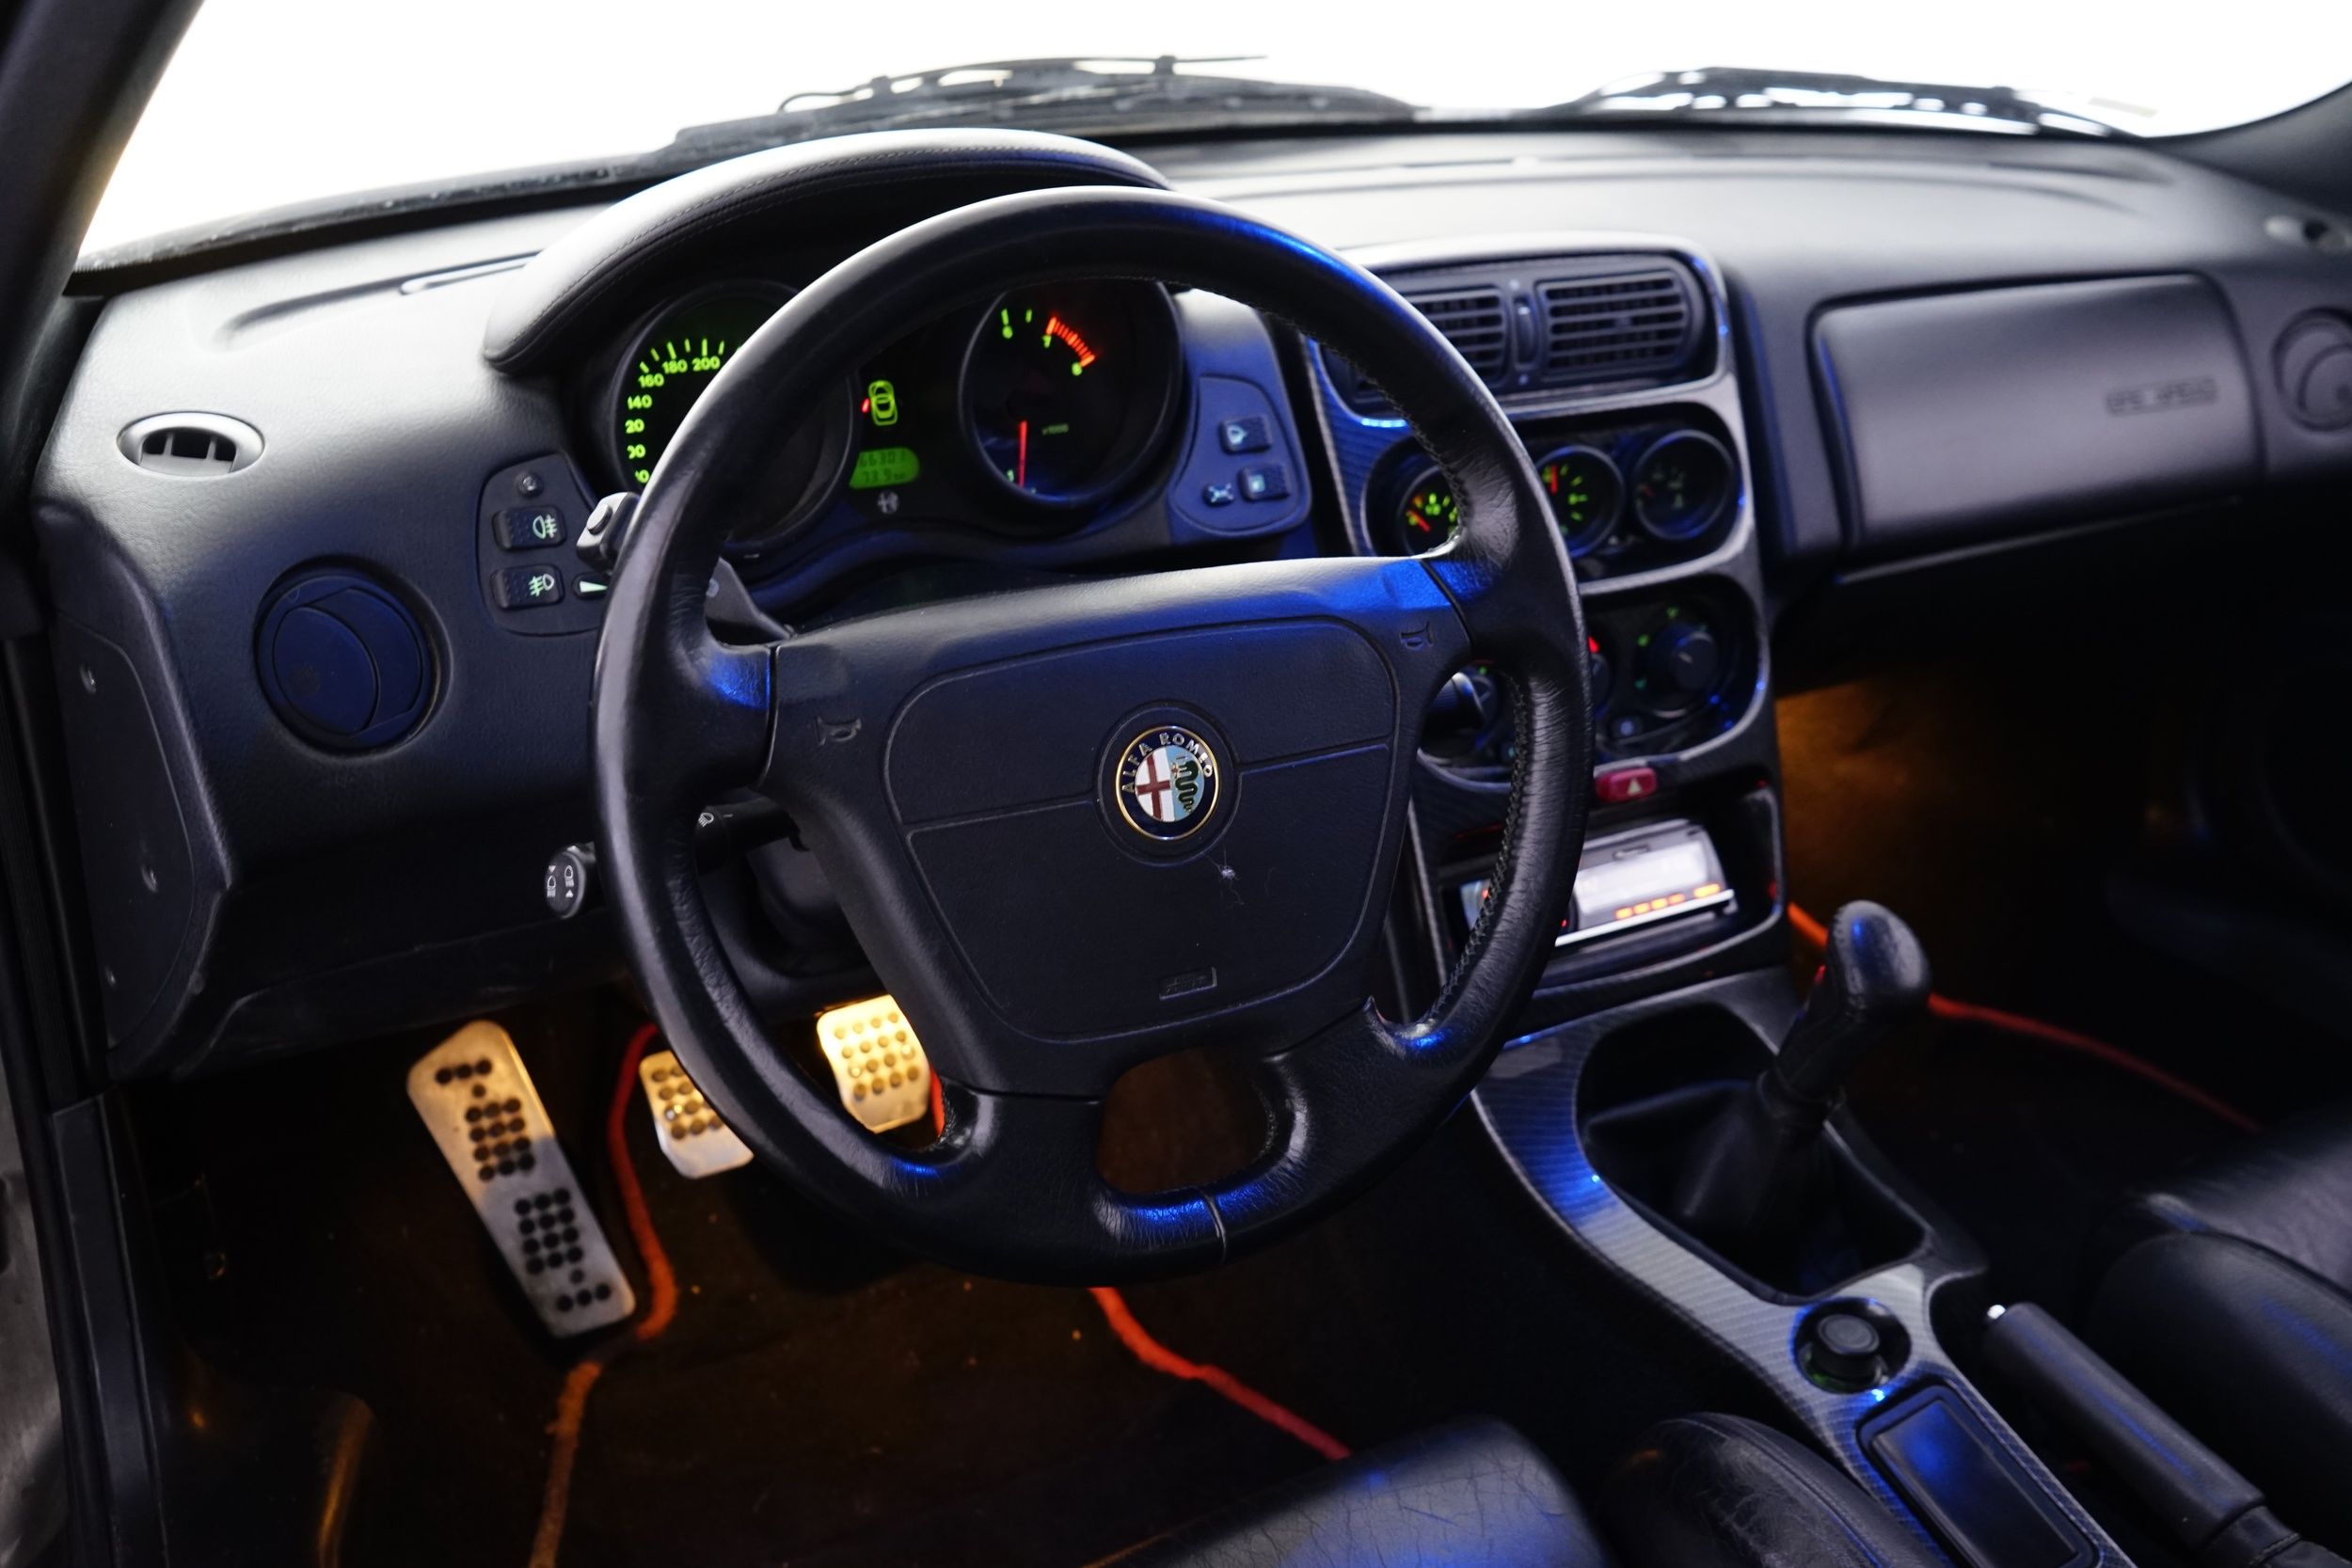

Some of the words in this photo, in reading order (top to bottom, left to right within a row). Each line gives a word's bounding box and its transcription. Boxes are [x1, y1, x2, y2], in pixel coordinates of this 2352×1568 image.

[661, 358, 688, 374] 180
[692, 356, 721, 371] 200
[639, 373, 665, 388] 160
[628, 394, 653, 409] 140
[1121, 742, 1153, 793] ALFA
[1159, 732, 1214, 778] ROMEO
